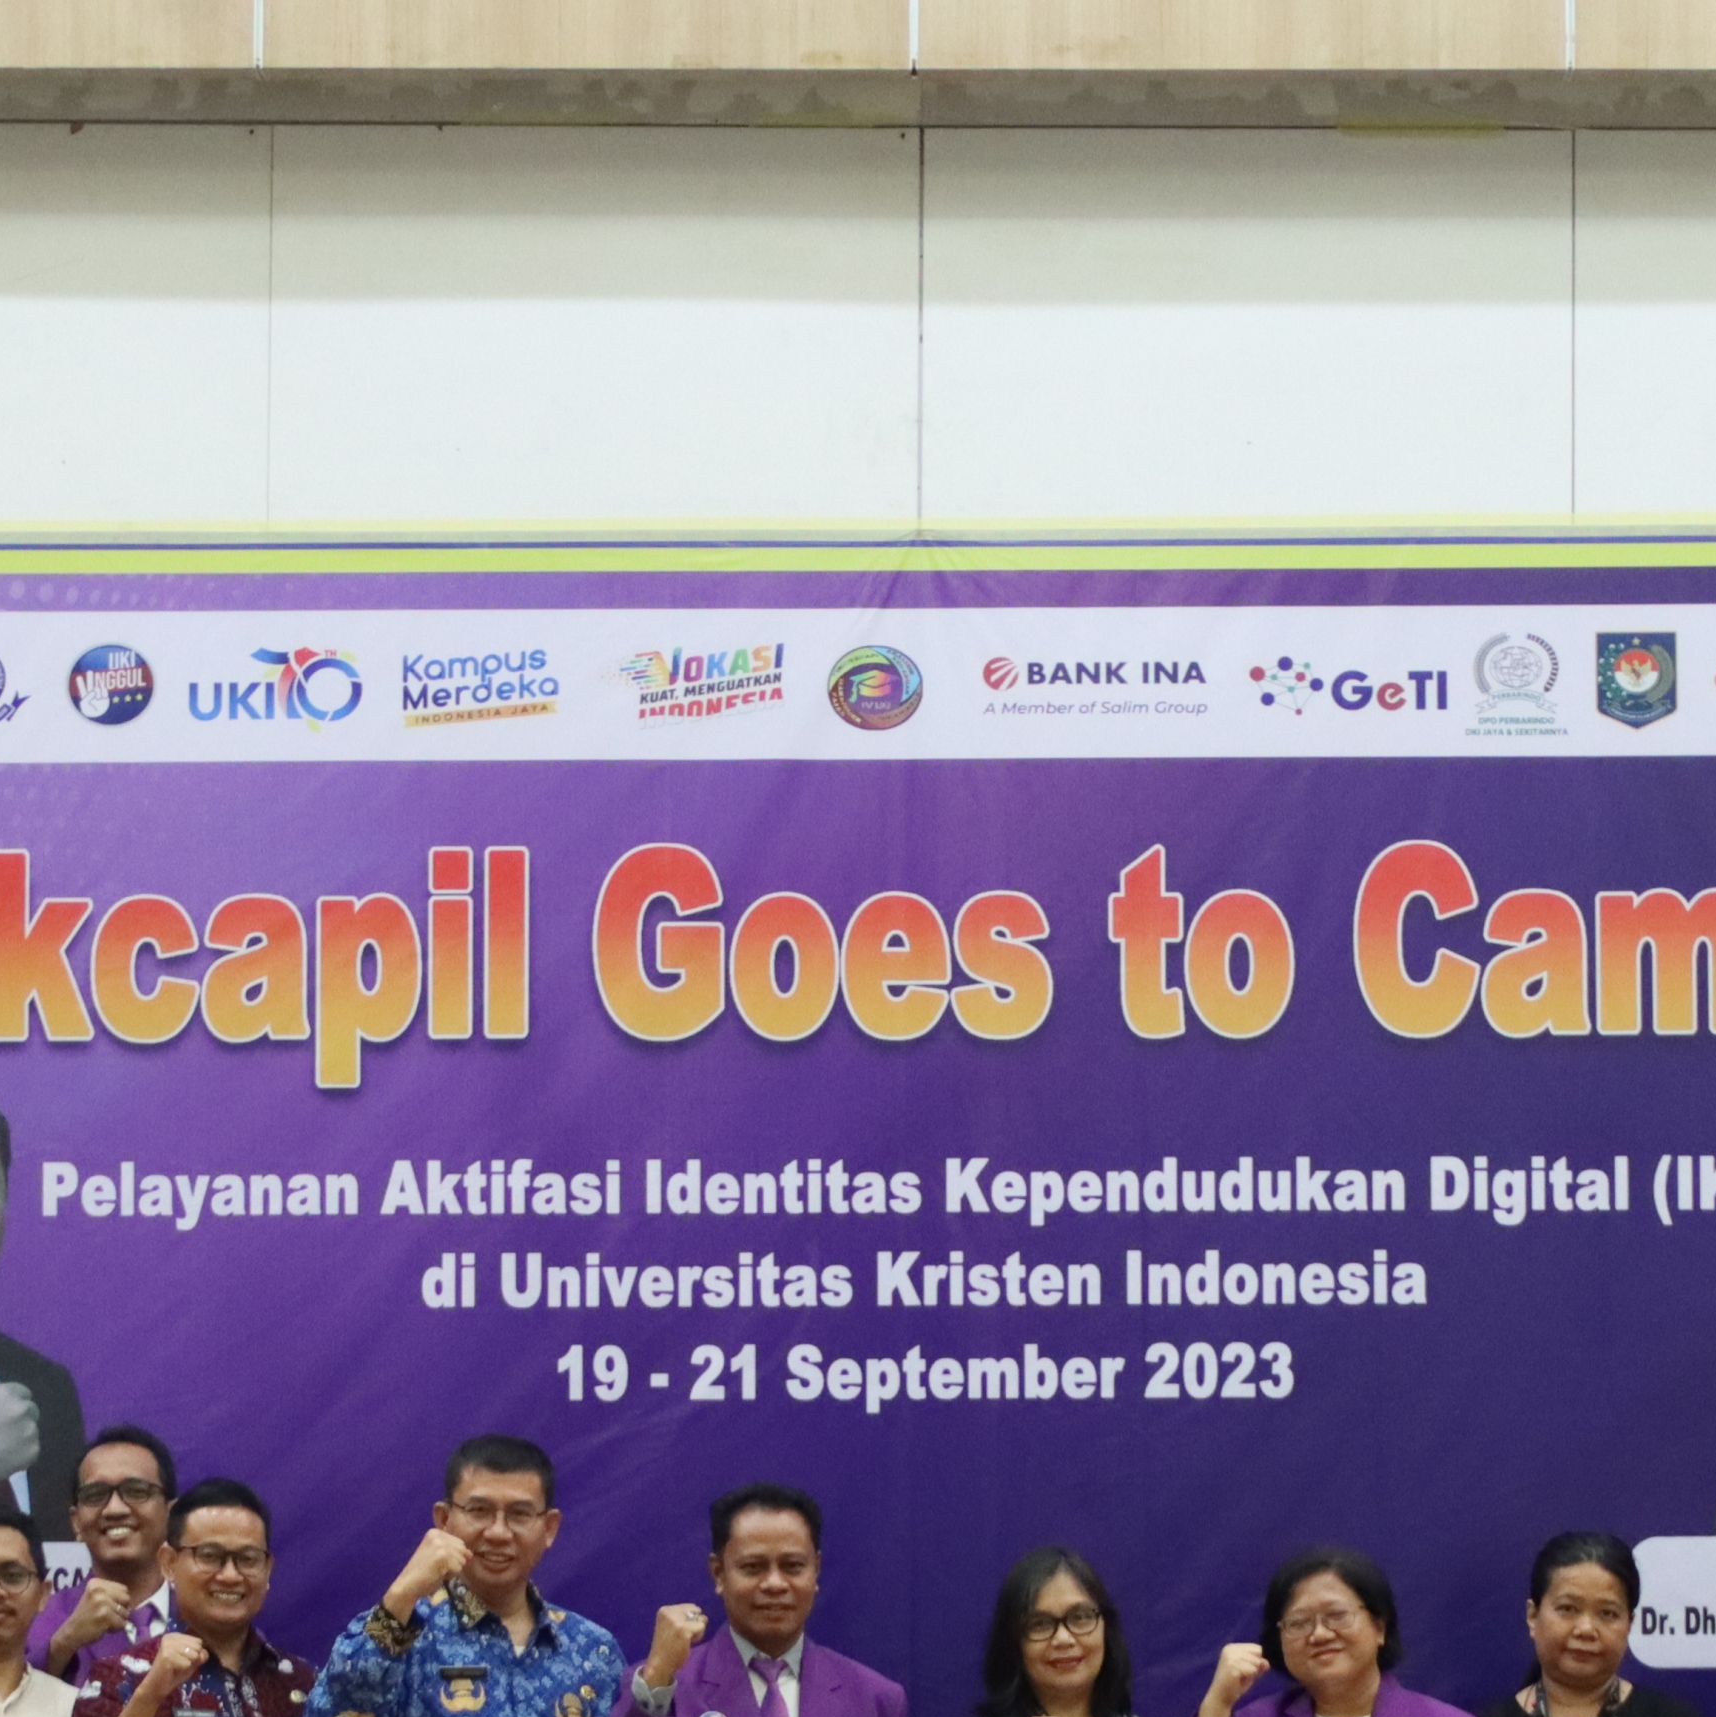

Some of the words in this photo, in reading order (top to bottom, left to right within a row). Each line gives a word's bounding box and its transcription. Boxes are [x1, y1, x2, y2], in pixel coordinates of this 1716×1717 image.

[108, 650, 135, 671] UKI
[402, 649, 547, 684] Kampus
[1027, 661, 1128, 685] BANK
[1141, 661, 1207, 684] INA
[189, 682, 275, 721] UKI
[402, 673, 560, 711] Merdeka
[639, 688, 680, 705] KUAT,
[683, 671, 782, 698] MENGUATKAN
[1331, 669, 1448, 711] GeTI
[414, 707, 502, 725] INDONESIA
[511, 702, 550, 716] JAYA
[984, 702, 996, 714] A
[1001, 701, 1075, 715] Member
[1078, 701, 1097, 715] of
[1100, 701, 1149, 714] Salim
[1154, 701, 1208, 716] Group
[591, 842, 1053, 1042] Goes
[1106, 843, 1295, 1040] to
[42, 1161, 359, 1231] Pelayanan
[380, 1158, 621, 1215] Aktifasi
[646, 1158, 922, 1215] Identitas
[945, 1156, 1405, 1226] Kependudukan
[1430, 1154, 1629, 1226] Digital
[421, 1252, 475, 1308] di
[501, 1252, 853, 1308] Universitas
[877, 1251, 1101, 1306] Kristen
[1125, 1249, 1427, 1305] Indonesia
[557, 1344, 628, 1401] 19
[690, 1344, 757, 1401] 21
[786, 1343, 1125, 1414] September
[1144, 1342, 1294, 1399] 2023
[1641, 1605, 1675, 1635] Dr.
